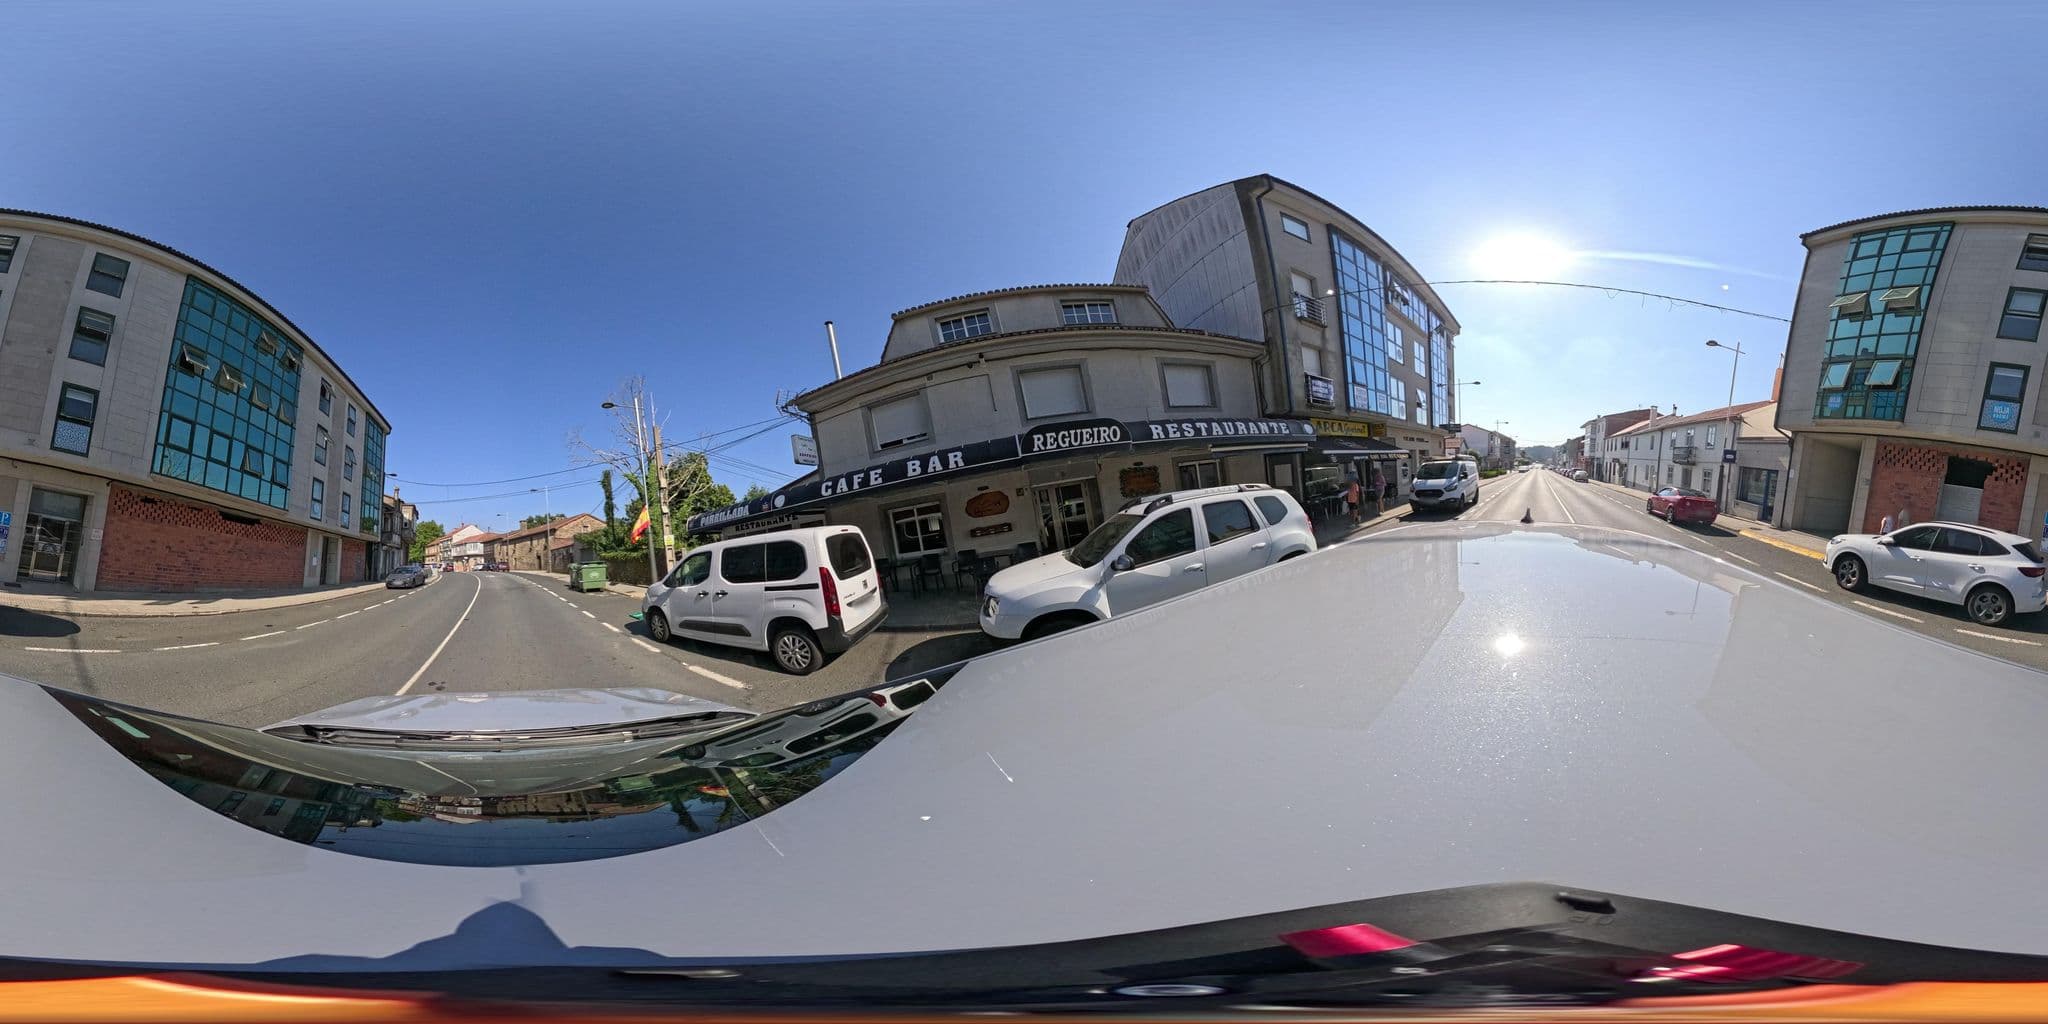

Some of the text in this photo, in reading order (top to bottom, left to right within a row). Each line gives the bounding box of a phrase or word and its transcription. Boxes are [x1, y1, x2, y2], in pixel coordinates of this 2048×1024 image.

[1032, 425, 1121, 452] REGUEIRO
[1149, 421, 1290, 440] RESTAURANTE
[821, 451, 965, 497] CAFE BAR
[701, 504, 750, 527] PARRILLADA
[735, 513, 799, 532] RESTAURANTE
